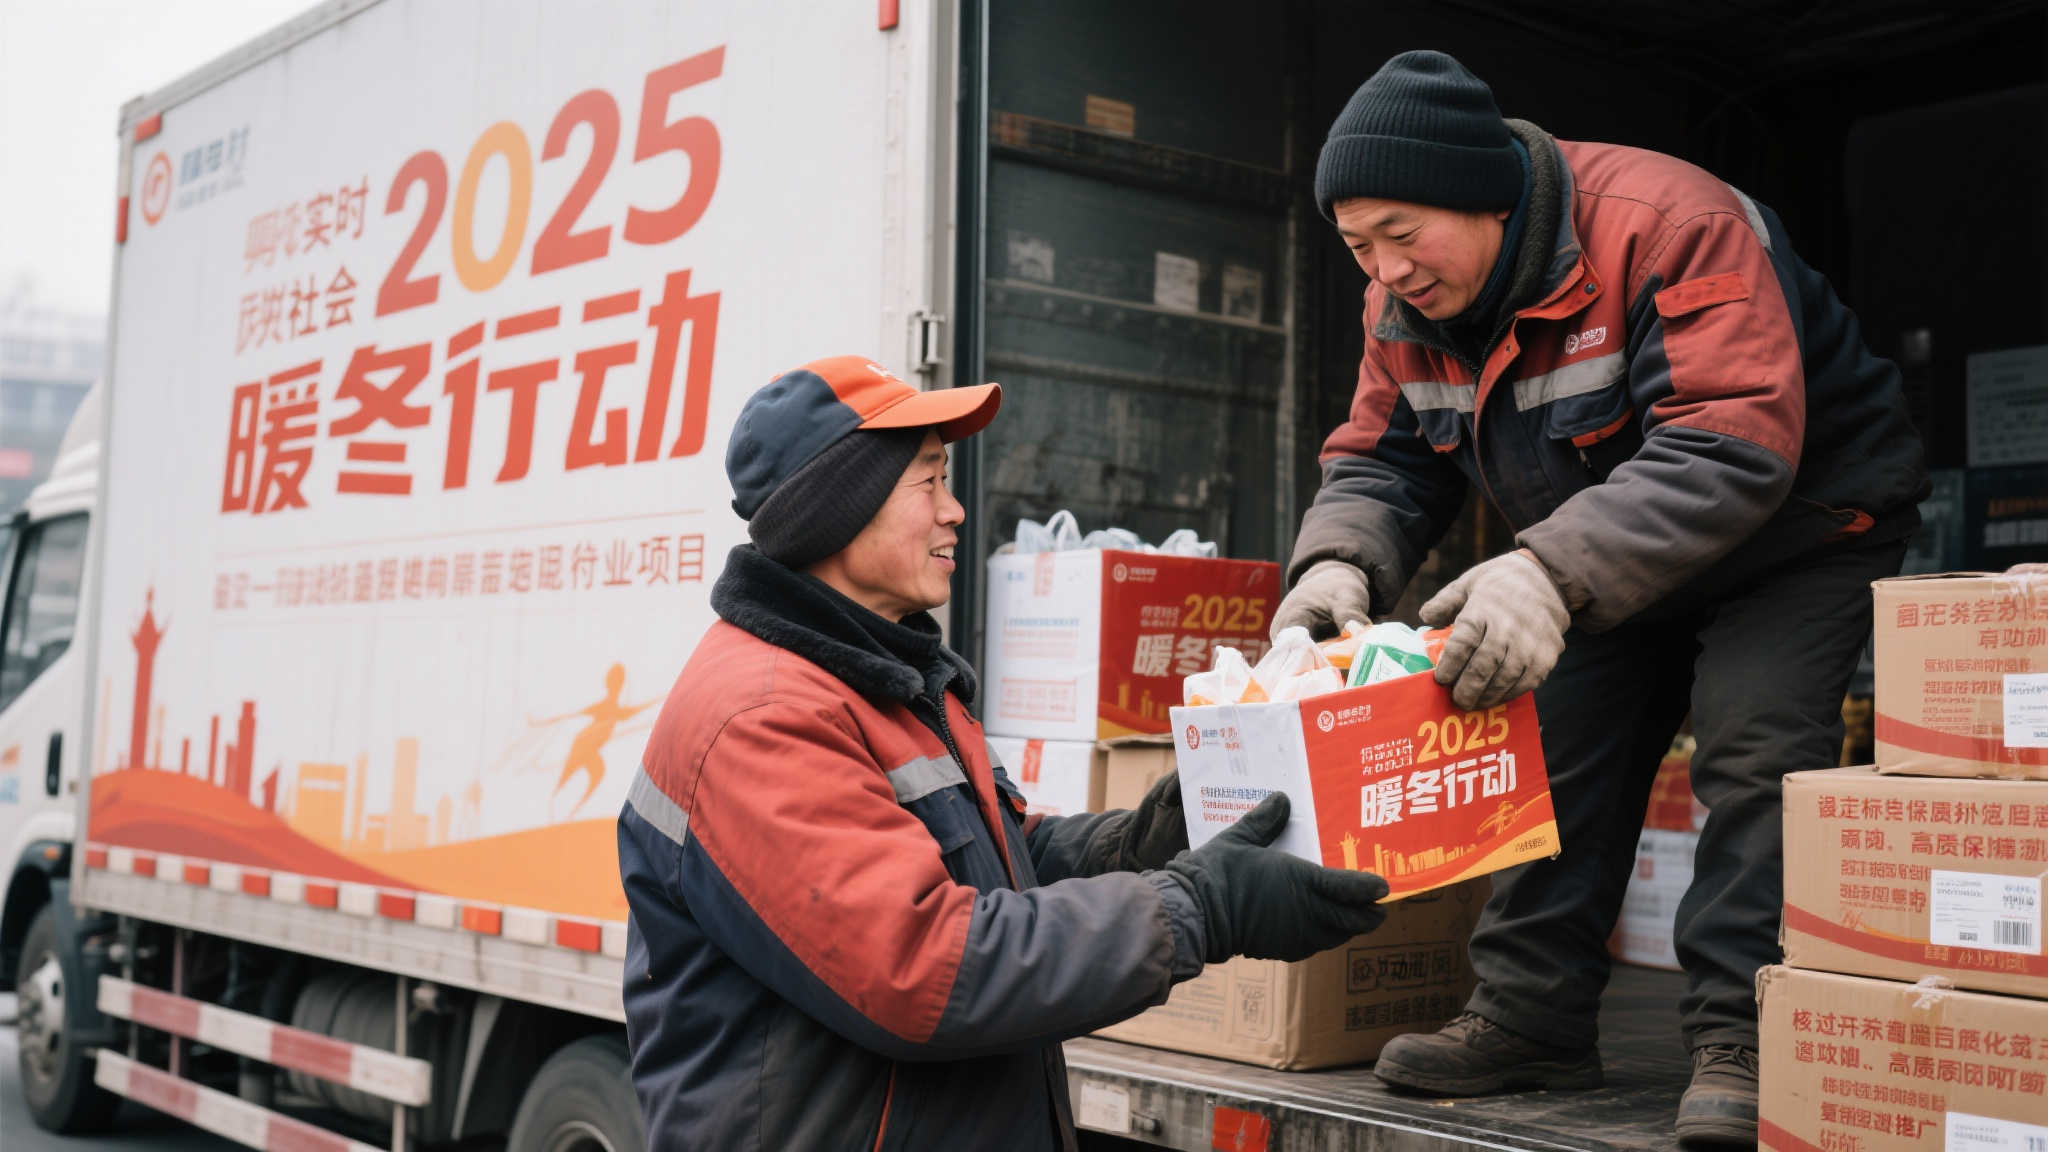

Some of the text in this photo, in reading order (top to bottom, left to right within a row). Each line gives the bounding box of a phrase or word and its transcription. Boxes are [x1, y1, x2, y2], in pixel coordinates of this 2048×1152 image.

[375, 45, 726, 318] 2025
[221, 268, 720, 515] 暖冬行动
[1181, 593, 1267, 632] 2025
[1417, 703, 1510, 763] 2025
[1361, 749, 1517, 828] 暖冬行动
